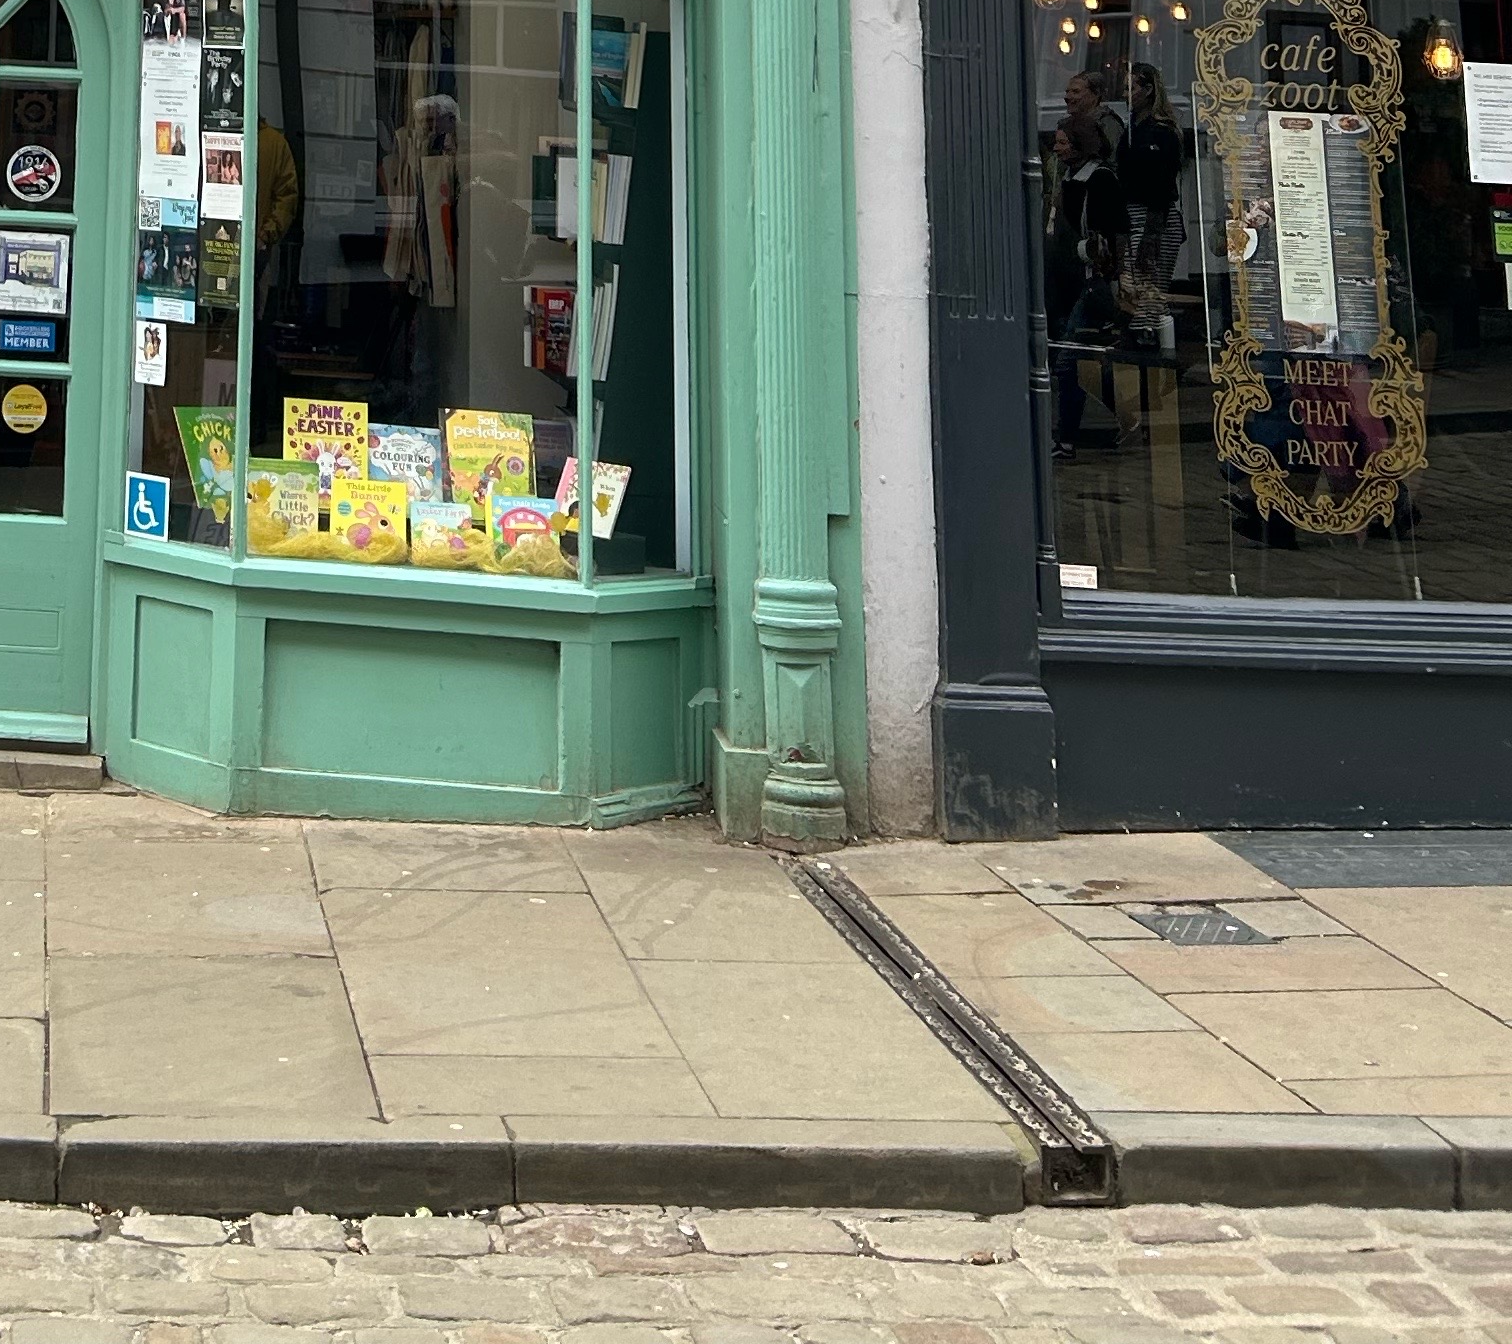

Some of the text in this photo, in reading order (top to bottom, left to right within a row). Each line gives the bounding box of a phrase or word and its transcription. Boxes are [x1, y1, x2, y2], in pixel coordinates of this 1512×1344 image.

[1259, 35, 1336, 74] cafe
[1259, 78, 1339, 111] zoot
[17, 155, 50, 169] 1916
[4, 337, 50, 349] MEMBER
[1282, 358, 1353, 387] MEET
[477, 414, 497, 429] Say
[1288, 398, 1352, 427] CHAT
[193, 420, 232, 443] CHICK
[297, 418, 355, 437] EASTER
[372, 450, 431, 464] COLOURING
[1286, 438, 1359, 467] PARTY
[392, 462, 412, 471] FUN
[278, 499, 309, 513] Little
